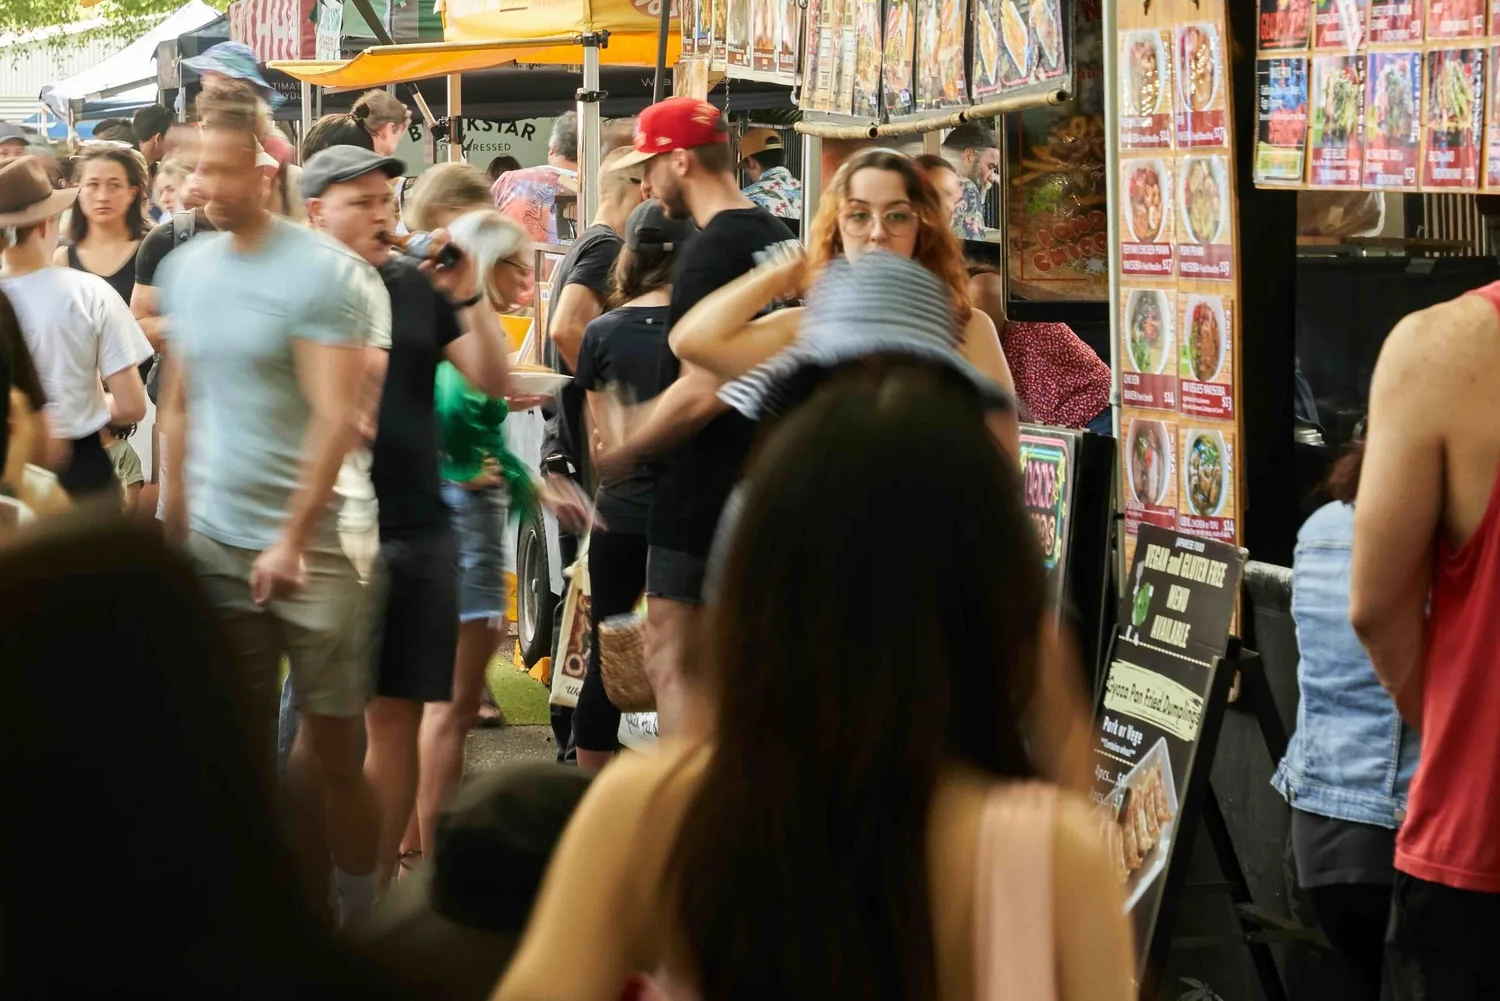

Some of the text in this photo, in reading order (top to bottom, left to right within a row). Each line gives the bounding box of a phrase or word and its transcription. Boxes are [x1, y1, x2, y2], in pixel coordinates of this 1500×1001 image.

[1145, 544, 1228, 588] VEGAN and GLUTEN FREE
[1166, 584, 1191, 613] MENU
[1150, 614, 1191, 649] AVAILABLE
[1106, 675, 1202, 730] Gyoza Pan Fried Dumplings
[1102, 716, 1143, 747] Pork or Vege
